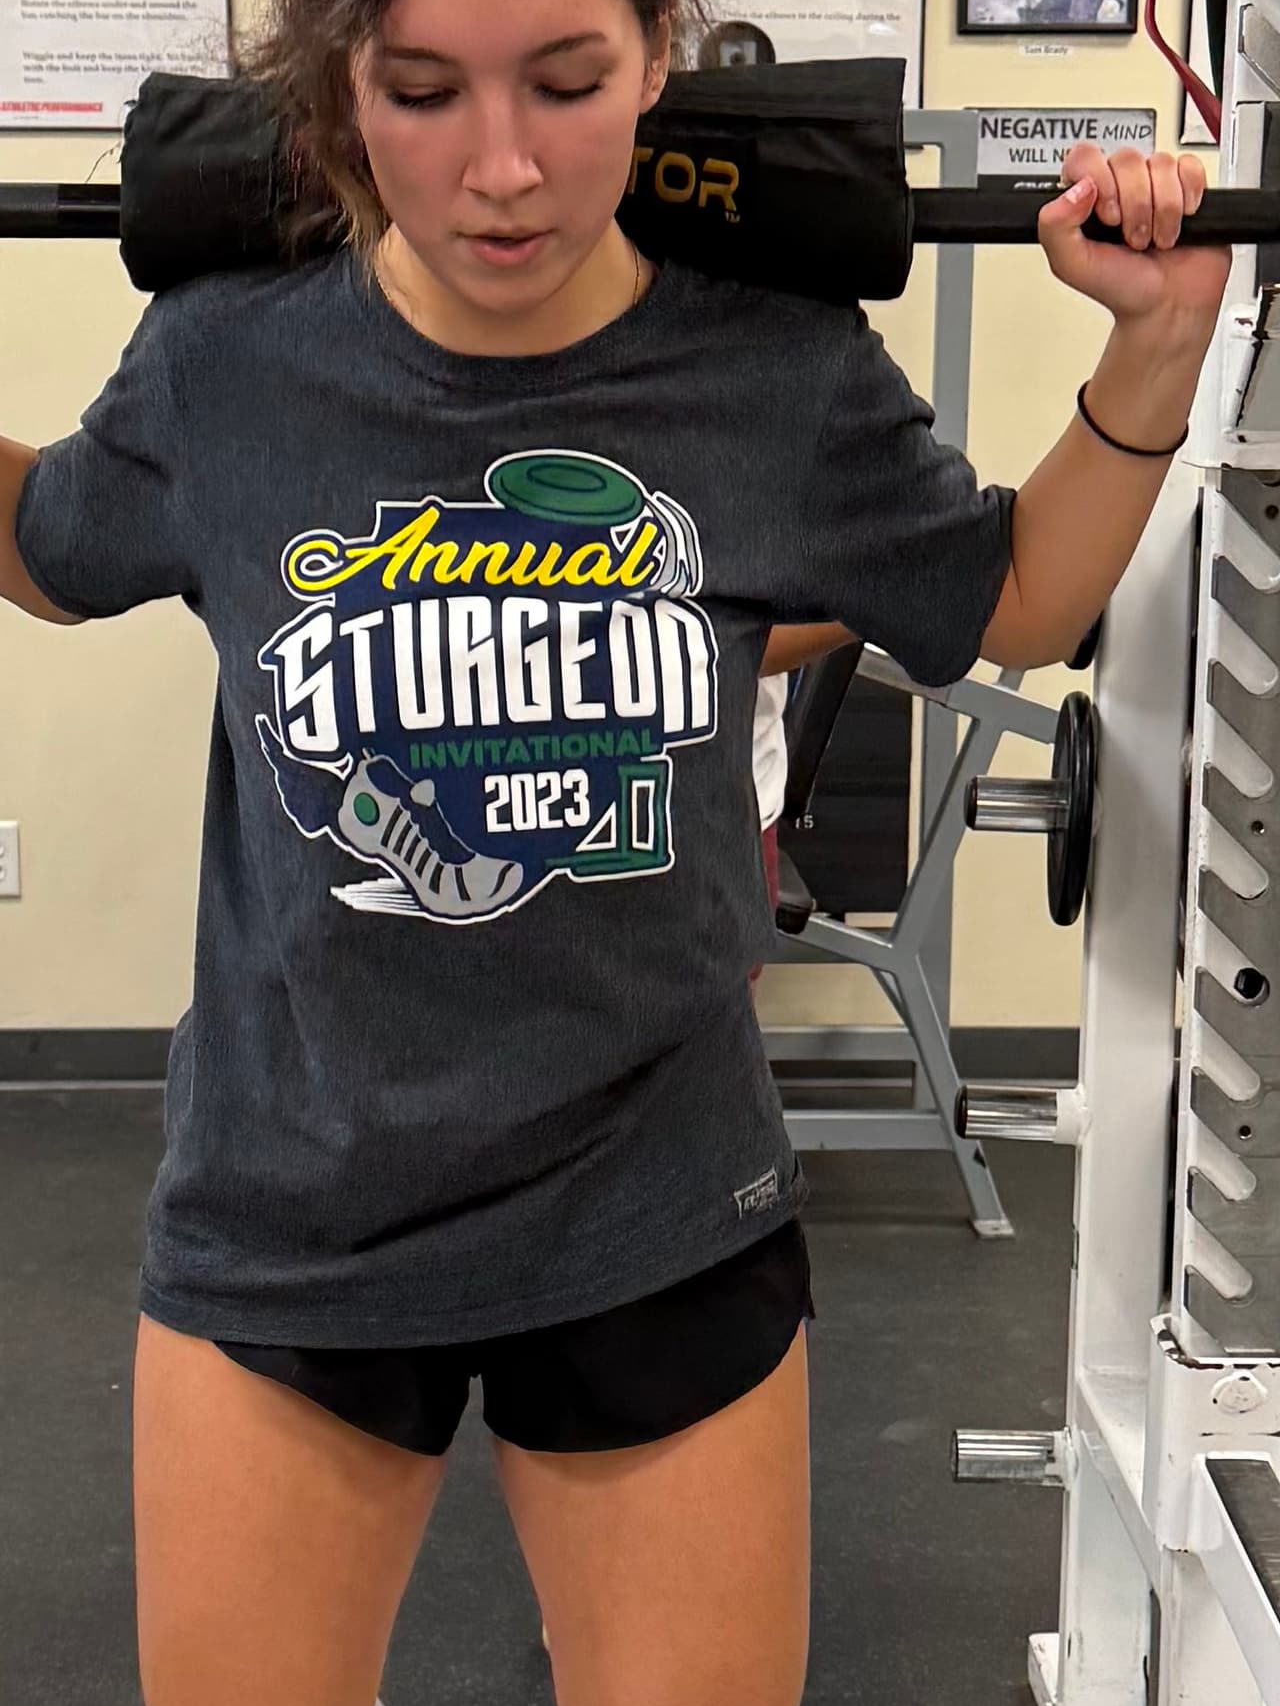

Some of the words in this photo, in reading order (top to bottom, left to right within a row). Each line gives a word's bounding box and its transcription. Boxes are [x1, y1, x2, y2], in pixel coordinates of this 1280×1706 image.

[980, 118, 1098, 139] NEGATIVE
[1102, 123, 1153, 140] MIND
[1009, 148, 1047, 163] WILL
[288, 506, 658, 591] Annual
[274, 595, 710, 753] STURGEON
[409, 728, 657, 770] INVITATIONAL
[484, 768, 591, 833] 2023
